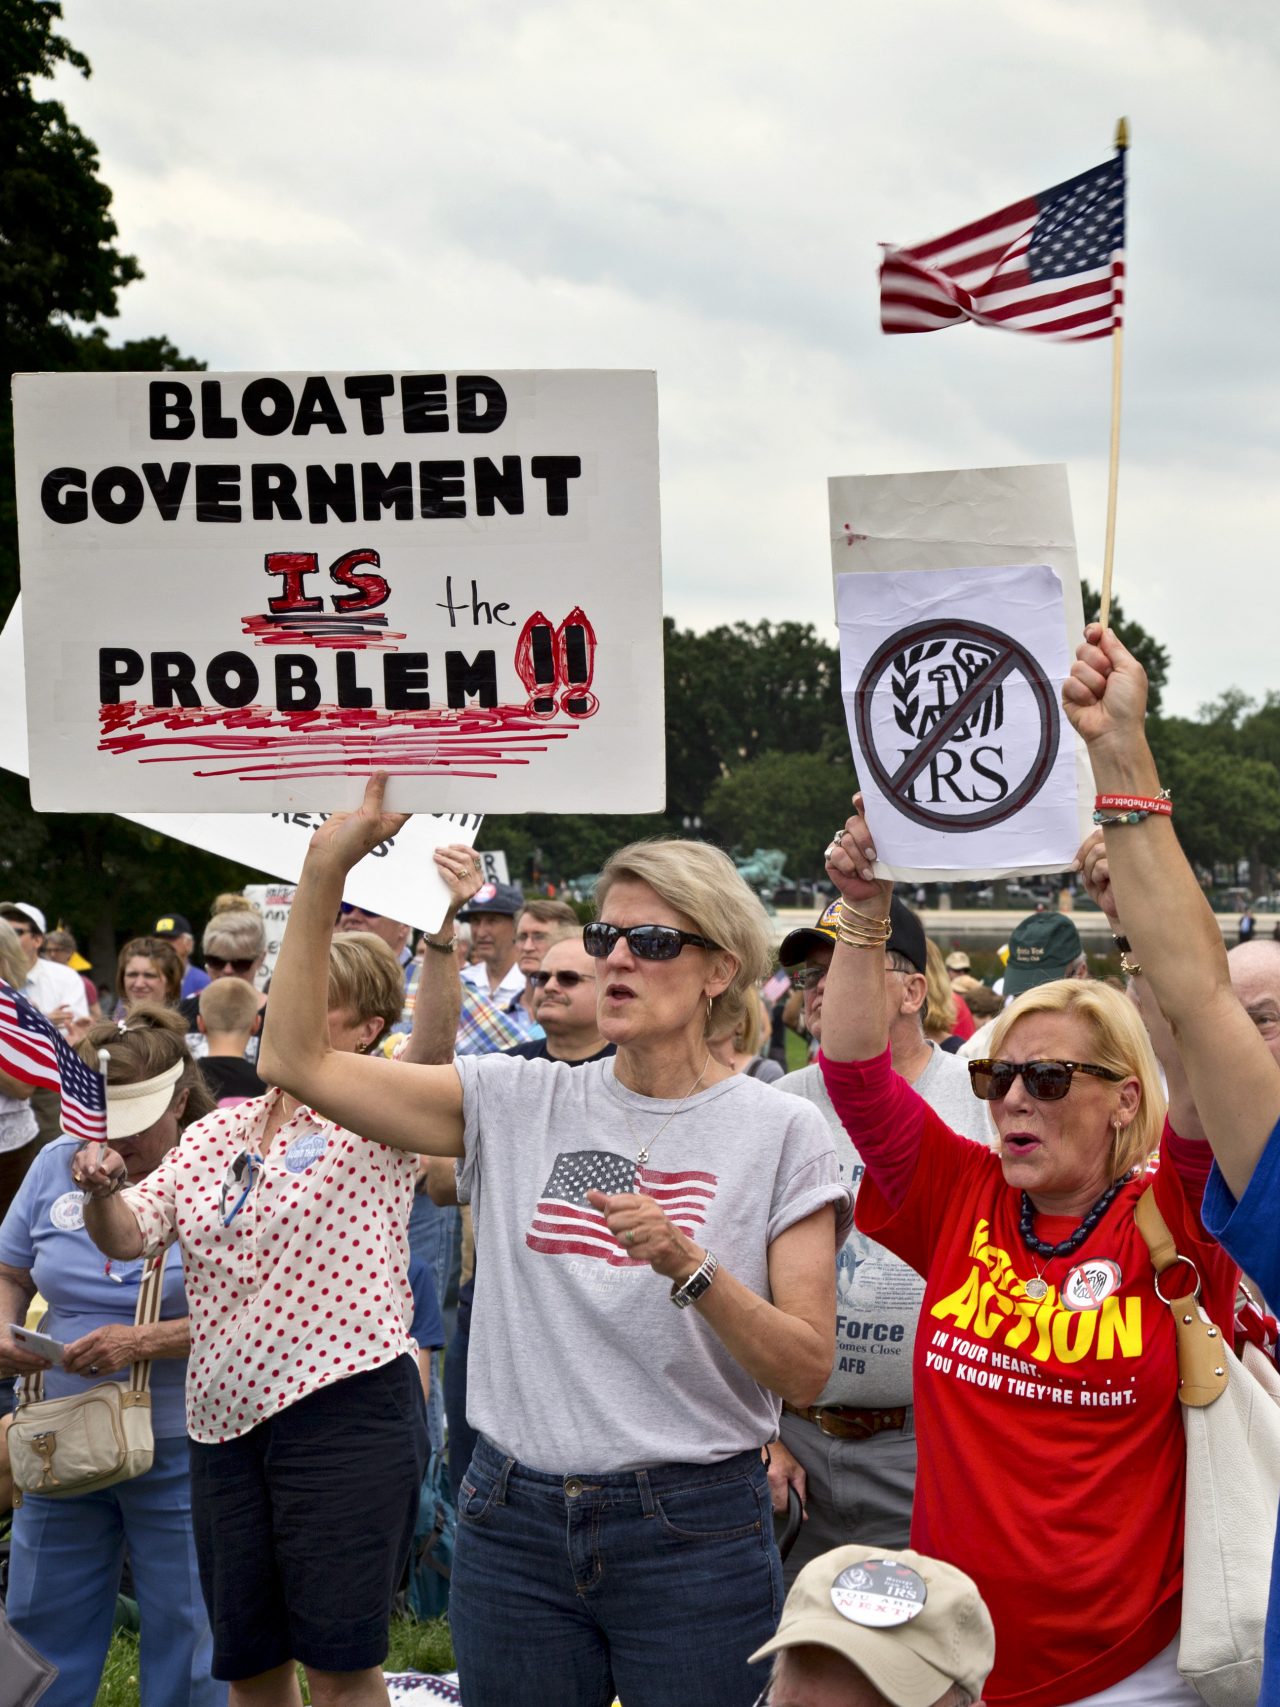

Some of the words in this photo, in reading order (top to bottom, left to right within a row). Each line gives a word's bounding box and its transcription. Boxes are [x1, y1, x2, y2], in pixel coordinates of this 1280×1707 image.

[149, 373, 508, 440] BLOATED
[41, 455, 582, 524] GOVERNMENT
[264, 548, 392, 614] IS
[436, 575, 517, 628] the
[897, 745, 1008, 803] IRS
[836, 1315, 904, 1342] Force
[930, 1266, 1143, 1363] ACTION
[836, 1340, 867, 1353] omes
[870, 1344, 901, 1355] Close
[838, 1356, 866, 1375] AFB
[932, 1330, 949, 1348] IN
[951, 1336, 987, 1364] YOUR
[925, 1351, 952, 1374] YOU
[956, 1363, 1003, 1390] KNOW
[1007, 1377, 1073, 1404] THEY'RE
[1081, 1389, 1136, 1406] RIGHT.
[836, 1591, 869, 1600] YOU
[882, 1599, 915, 1609] ARE
[887, 1586, 917, 1600] IRS
